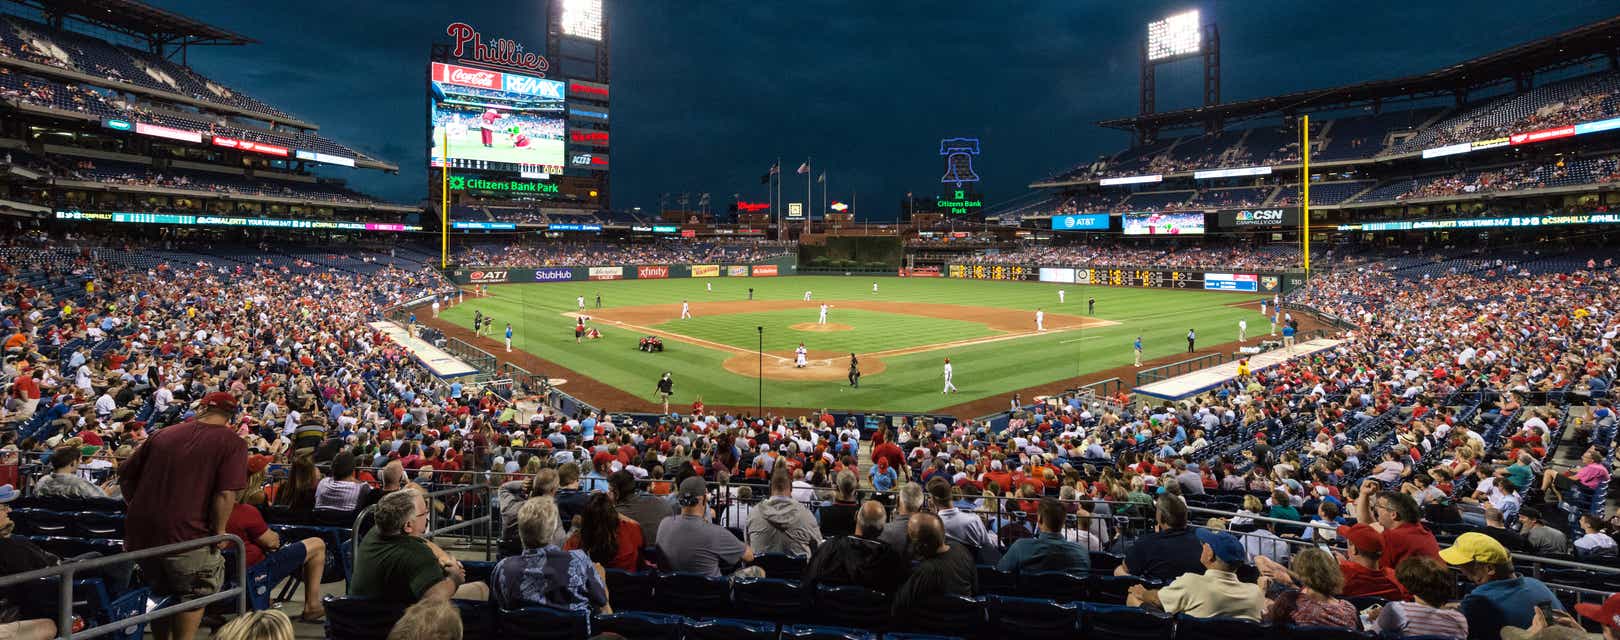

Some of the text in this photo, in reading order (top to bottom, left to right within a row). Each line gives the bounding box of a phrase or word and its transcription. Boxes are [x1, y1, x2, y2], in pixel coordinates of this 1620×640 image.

[447, 22, 549, 71] Phillies
[451, 68, 495, 87] Coca-Cola
[506, 76, 563, 99] RE/MAX
[467, 178, 559, 193] Citizens Bank Park
[1253, 209, 1283, 219] CSN
[1076, 217, 1095, 226] AT&T
[1541, 215, 1589, 225] @CSNPHILLY
[483, 271, 508, 279] ATI
[535, 270, 572, 280] StubHub
[640, 266, 666, 278] xfinity
